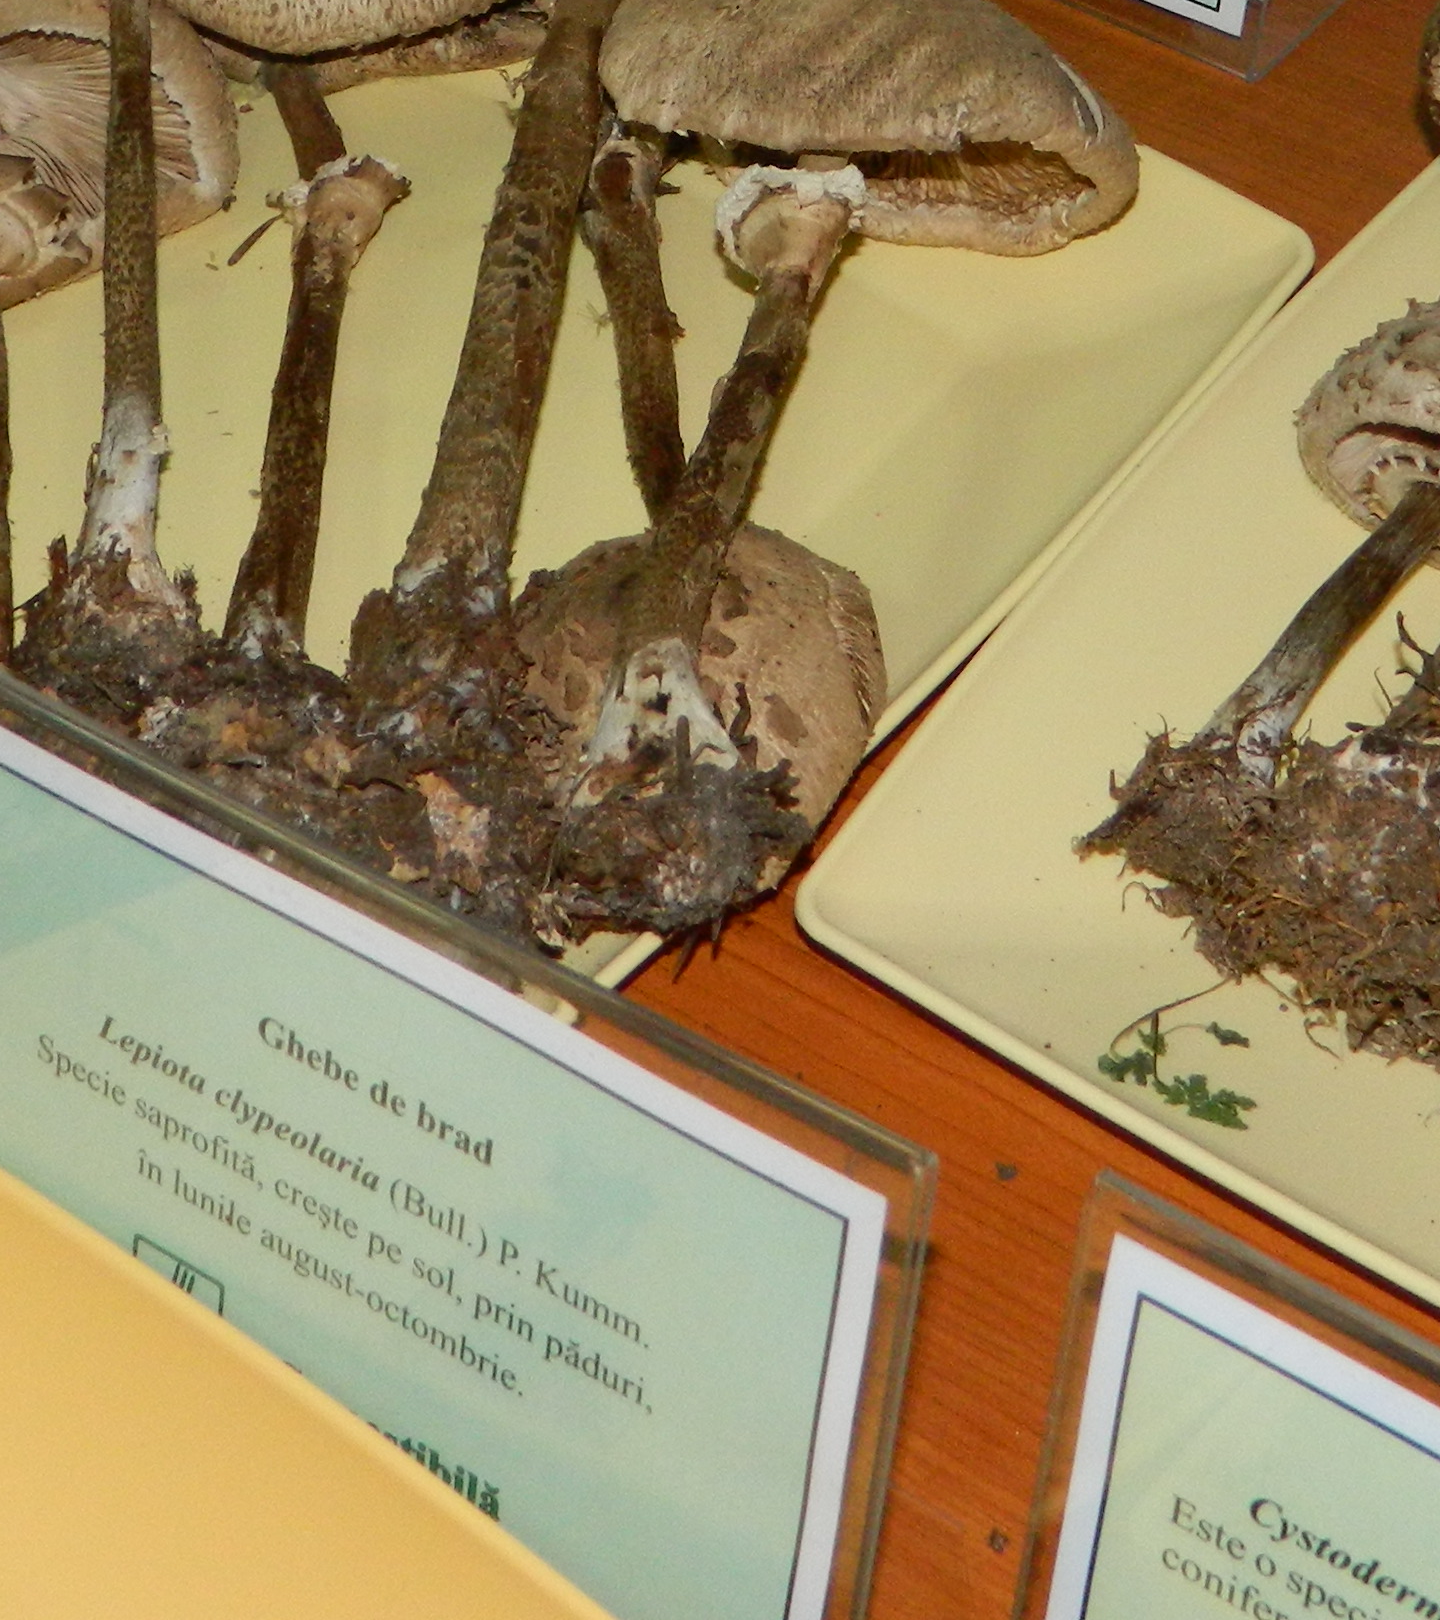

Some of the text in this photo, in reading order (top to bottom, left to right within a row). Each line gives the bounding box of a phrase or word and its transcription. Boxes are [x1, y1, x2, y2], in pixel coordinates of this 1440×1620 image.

[98, 1014, 207, 1096] Lepiota
[214, 1088, 381, 1193] clypeolaria
[388, 1178, 489, 1258] (Bull.)
[257, 1015, 494, 1168] Ghebe de brad
[36, 1033, 127, 1107] Specie
[366, 1230, 403, 1266] pe
[472, 1292, 535, 1344] prin
[137, 1147, 163, 1187] în
[172, 1168, 252, 1237] lunile
[1169, 1493, 1278, 1579] Este o
